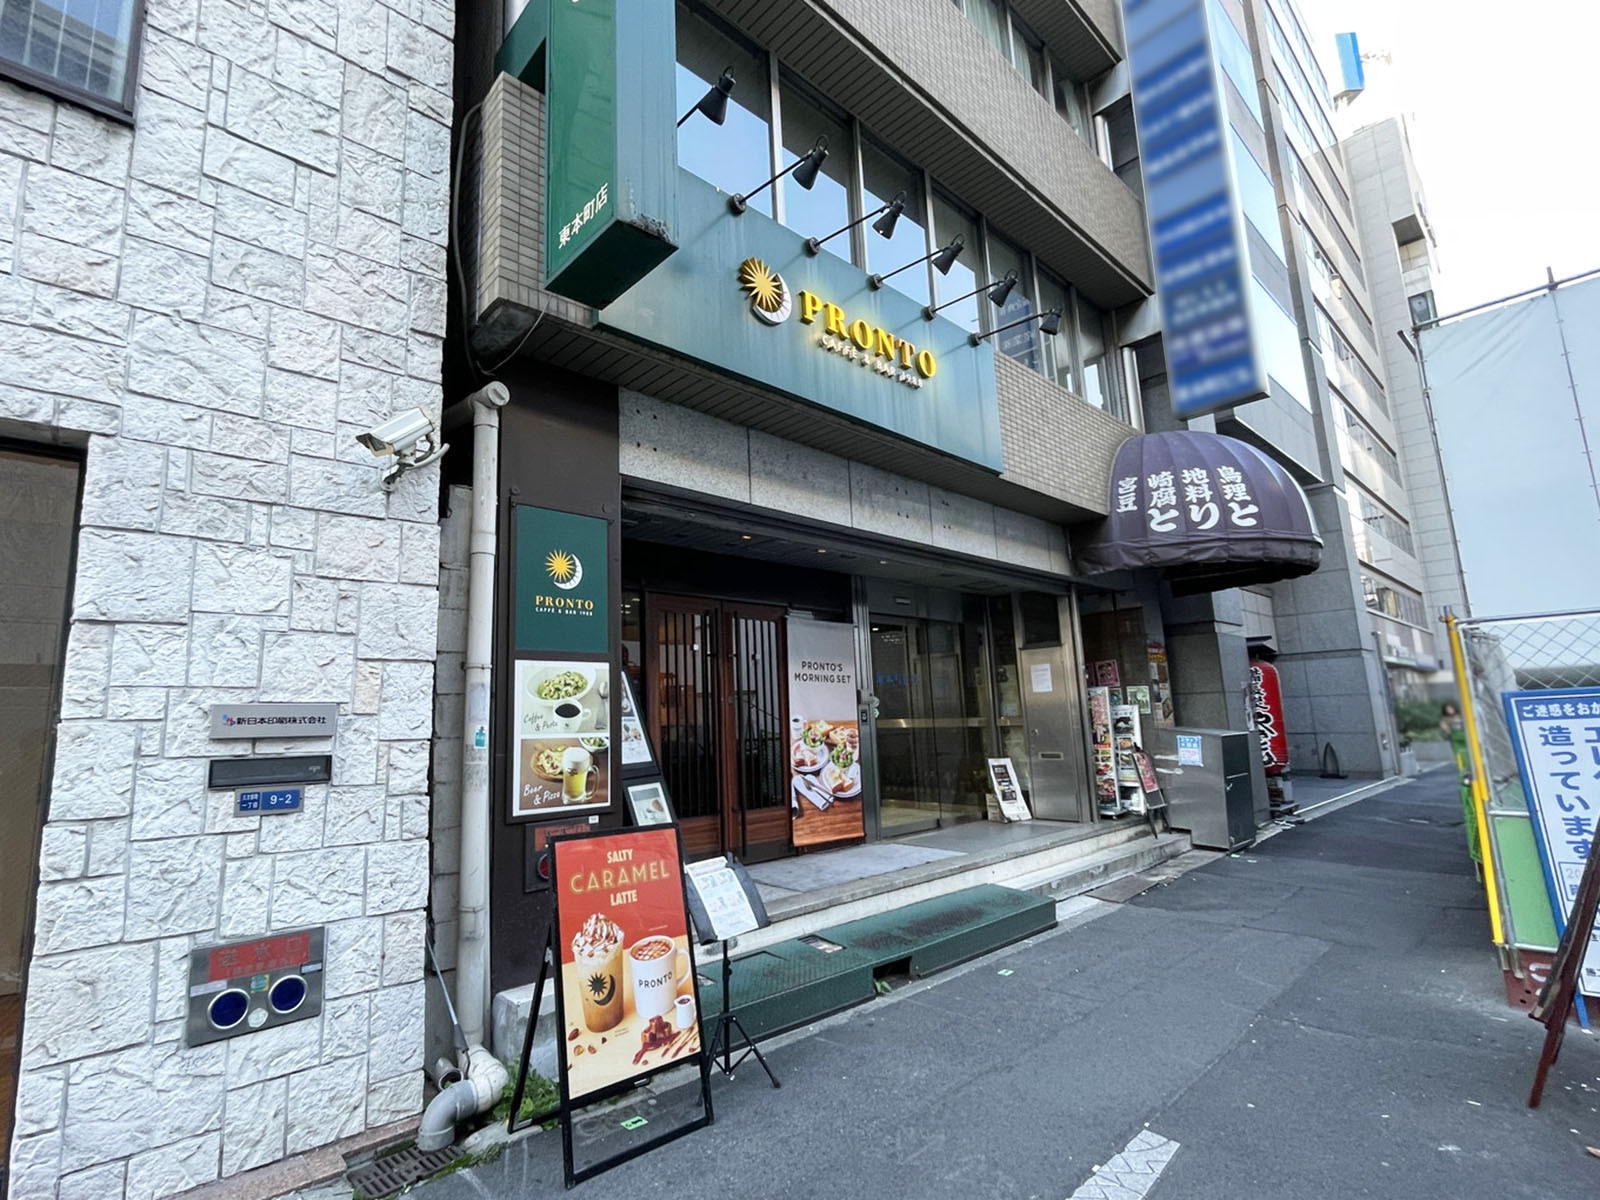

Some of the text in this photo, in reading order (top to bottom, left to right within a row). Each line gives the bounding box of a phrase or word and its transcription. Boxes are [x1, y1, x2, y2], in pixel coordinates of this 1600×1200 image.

[558, 183, 609, 249] 東本町店
[797, 289, 938, 380] PRONTO
[873, 359, 897, 379] BAR
[1116, 483, 1252, 513] 豆腐料理
[1147, 501, 1260, 532] とりと
[535, 595, 594, 610] PRONTO
[801, 661, 843, 672] PRONTO'S
[794, 673, 851, 684] MORNING SET
[236, 715, 327, 726] 新日本印刷株式会社
[534, 721, 559, 732] & Pasta
[523, 783, 543, 797] Beer
[533, 789, 561, 806] & Pizza
[1538, 724, 1596, 860] 造っています
[241, 801, 258, 809] 一丁目
[270, 793, 292, 805] 9-2
[606, 849, 633, 864] SALTY
[570, 860, 670, 894] CARAMEL
[610, 889, 638, 906] LATTE
[638, 971, 673, 989] PRONTO
